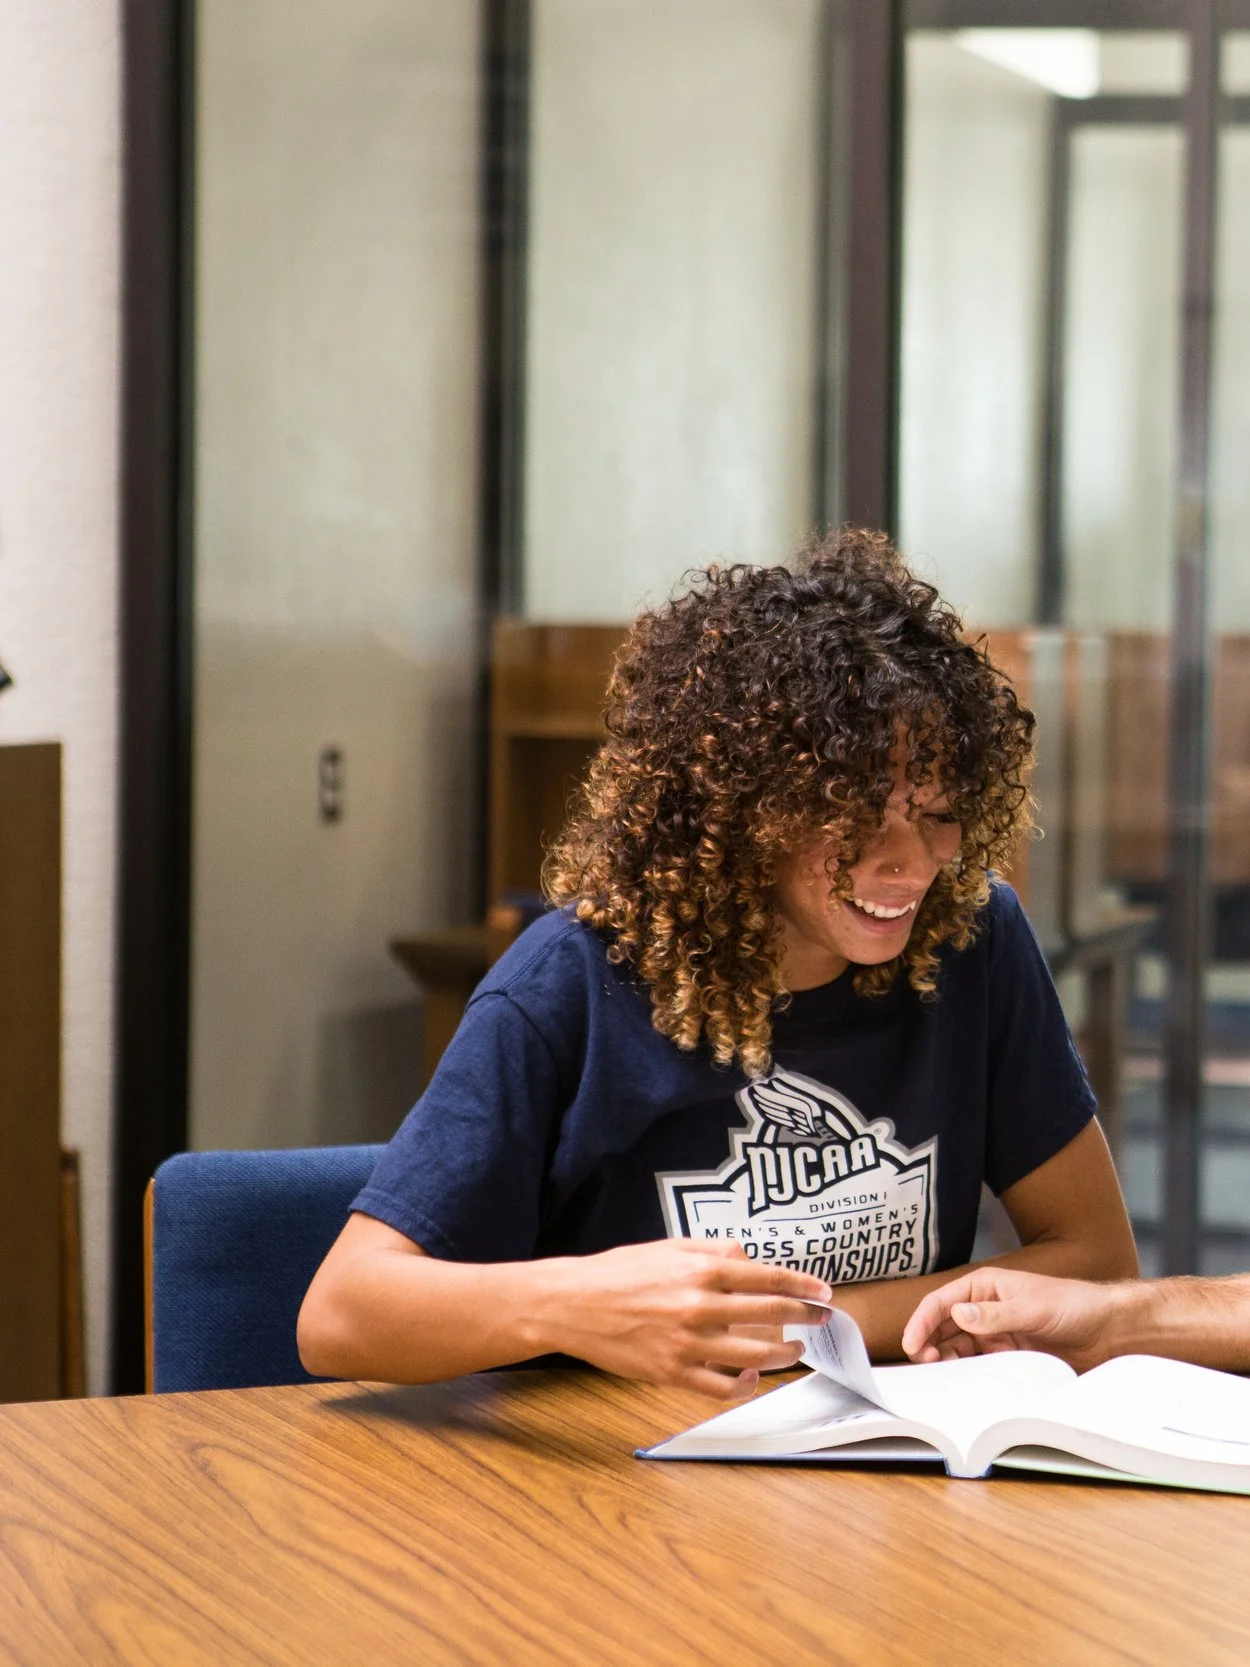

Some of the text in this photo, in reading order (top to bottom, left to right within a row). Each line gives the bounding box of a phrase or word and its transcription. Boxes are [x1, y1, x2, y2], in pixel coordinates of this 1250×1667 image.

[746, 1136, 877, 1211] NJCAA
[705, 1203, 918, 1239] MEN'S & WOMEN'S
[809, 1193, 878, 1213] DIVISION
[744, 1217, 917, 1259] OSS COUNTRY
[762, 1237, 914, 1284] ONSHIPS
